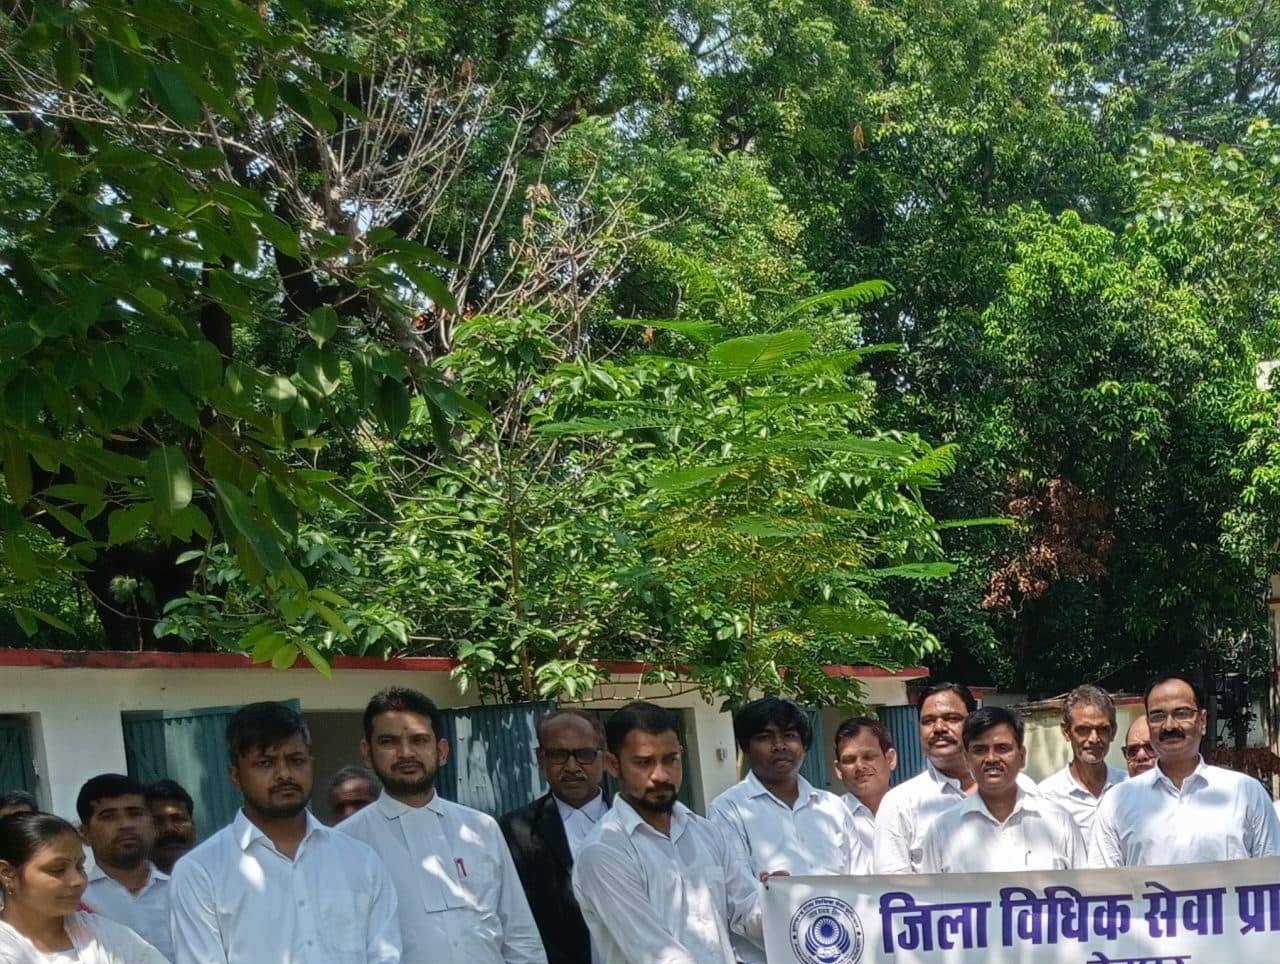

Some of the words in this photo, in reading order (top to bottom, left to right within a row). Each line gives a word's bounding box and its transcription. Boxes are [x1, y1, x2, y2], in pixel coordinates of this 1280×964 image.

[879, 891, 992, 953] जिला
[1000, 886, 1134, 946] विधिक
[1142, 881, 1227, 938] सेवा
